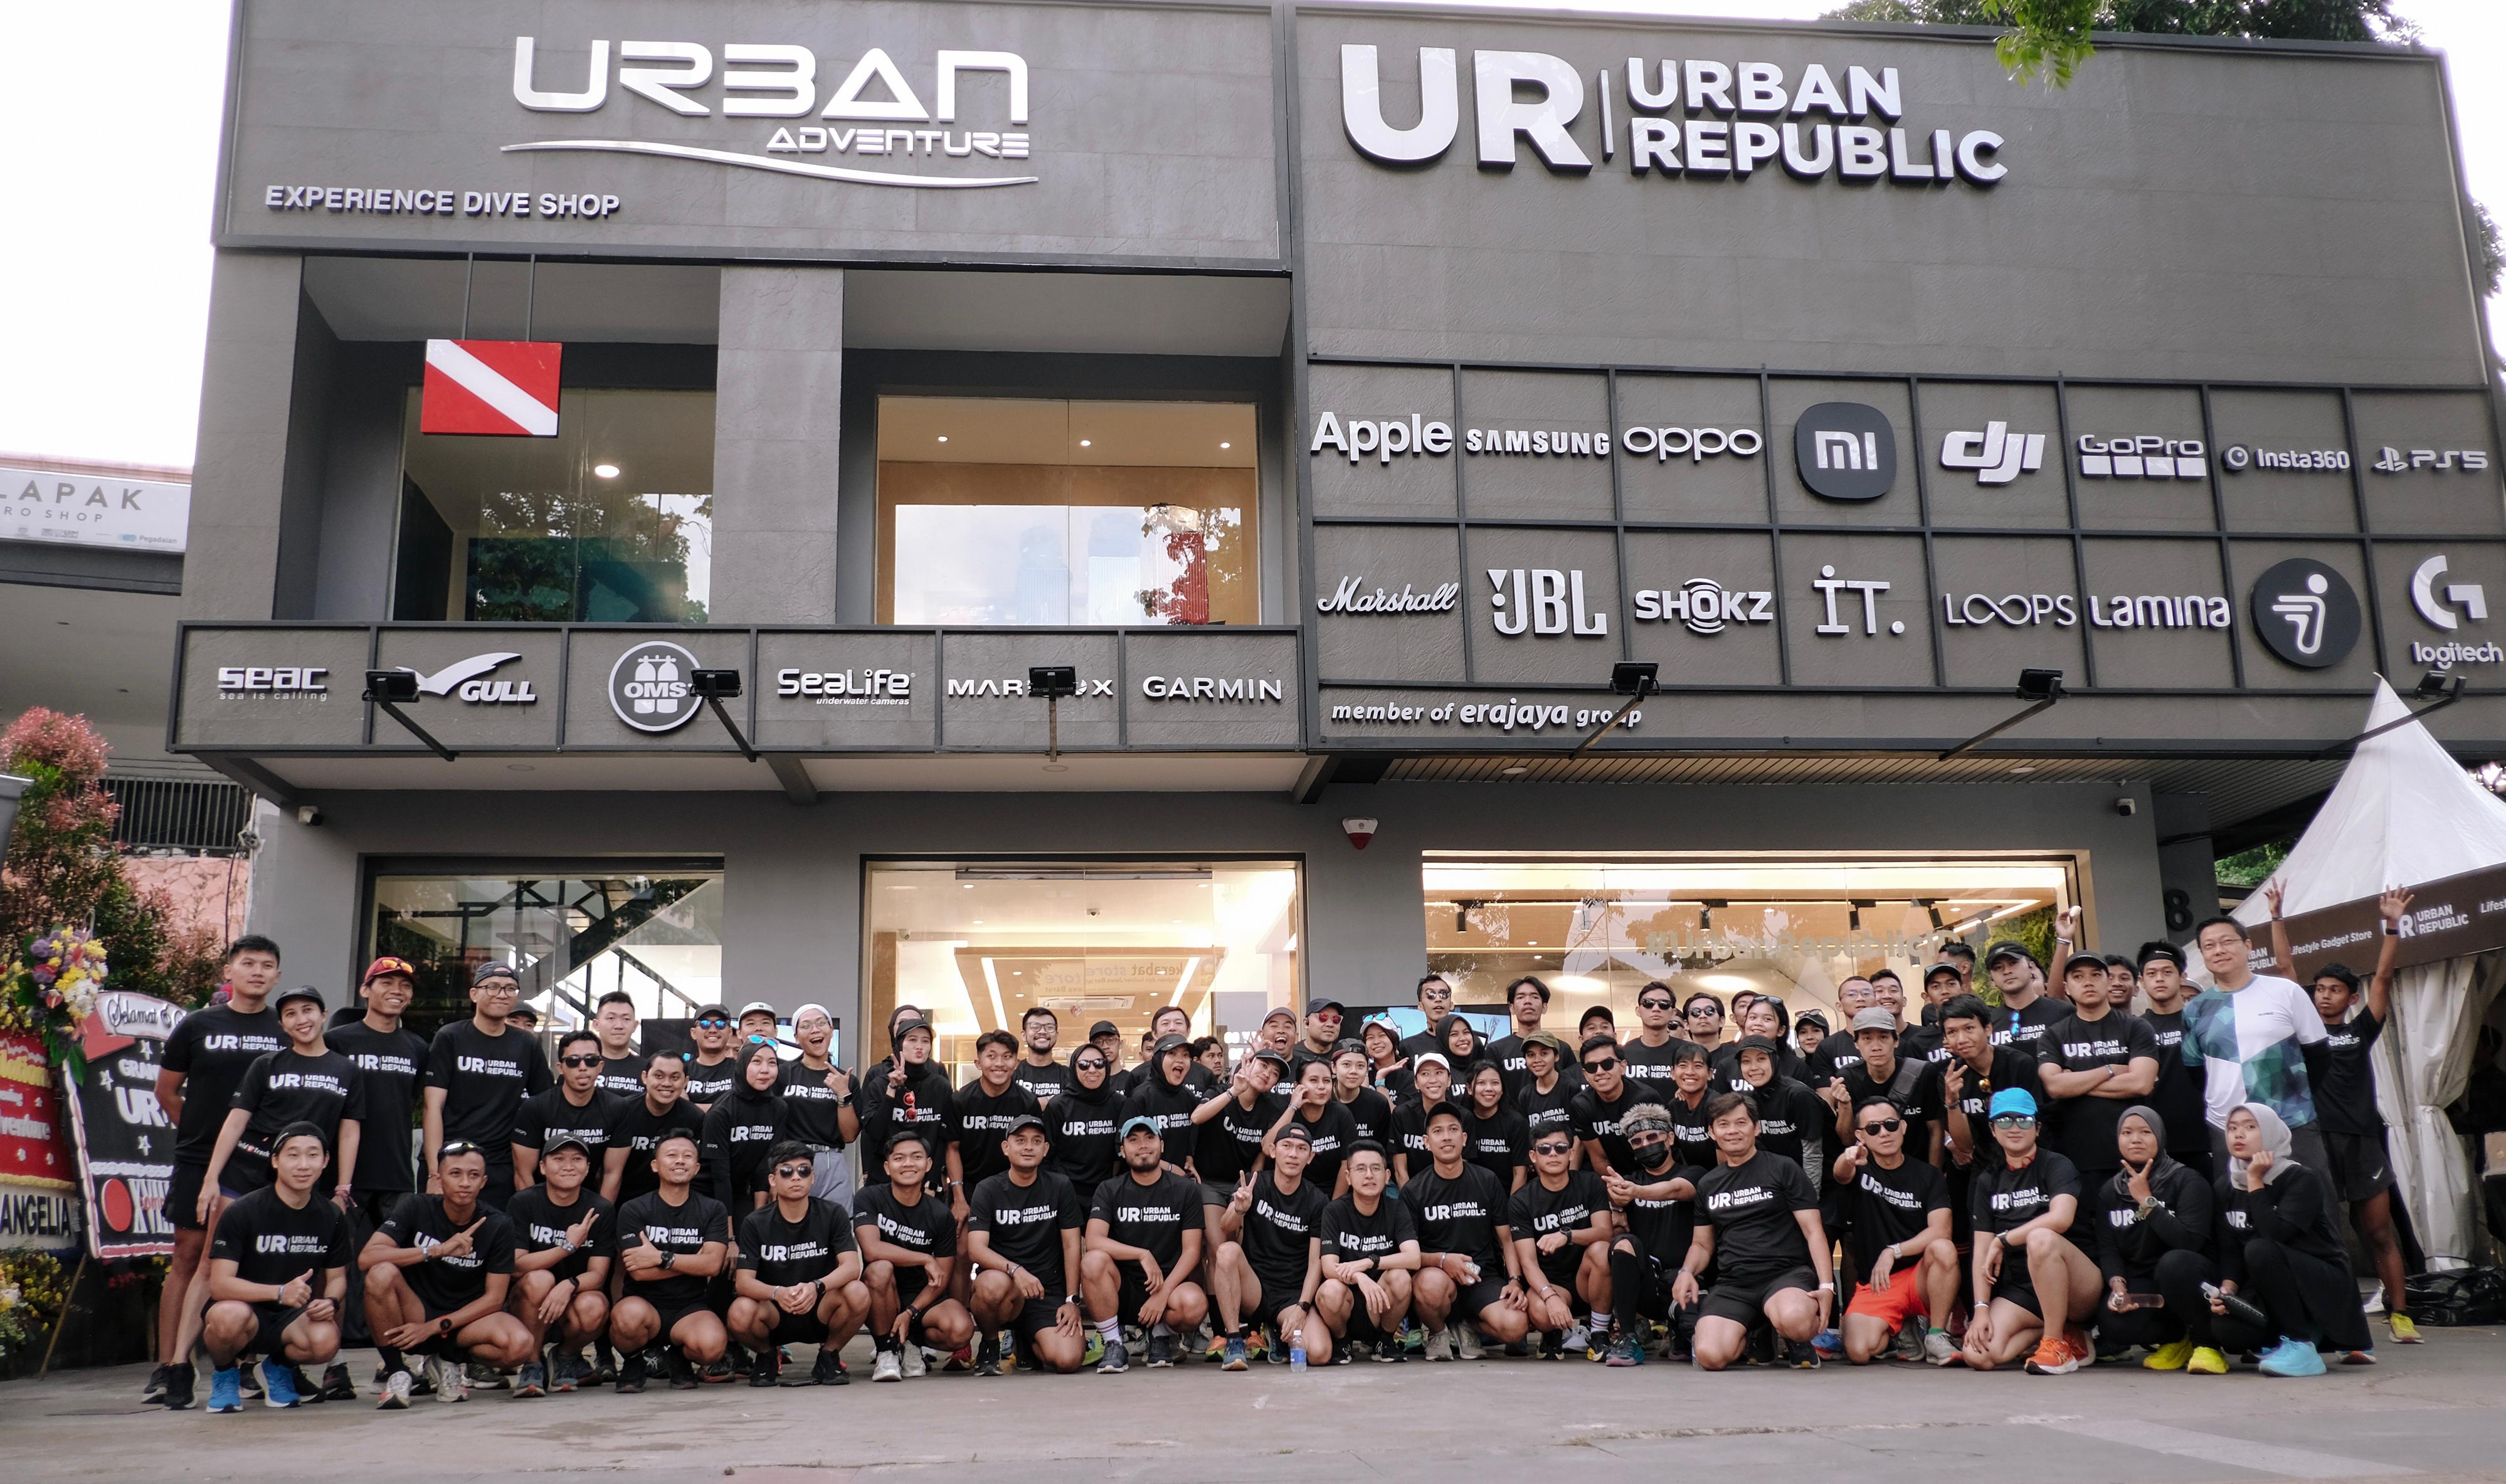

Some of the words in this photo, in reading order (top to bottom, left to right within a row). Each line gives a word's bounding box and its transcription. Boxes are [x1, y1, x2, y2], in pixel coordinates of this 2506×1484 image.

[513, 36, 1029, 124] URBAN
[1626, 57, 1901, 124] URBAN
[1338, 43, 1594, 175] UR
[767, 127, 1030, 158] ADVENTURE
[1631, 117, 2009, 187] REPUBLIC
[266, 185, 455, 213] EXPERIENCE
[463, 191, 531, 217] DIVE
[538, 193, 620, 219] SHOP
[1311, 411, 1452, 464] Apple
[1465, 429, 1610, 456] SAMSUNG
[2079, 434, 2204, 455] GoPro
[2256, 448, 2350, 470] Insta360
[2409, 450, 2488, 470] PS5
[0, 480, 144, 510] APAK
[45, 510, 102, 522] SHOP
[139, 535, 177, 544] Pegadaian
[1317, 576, 1459, 613] Marshall
[1493, 569, 1608, 636] JBL
[1634, 589, 1774, 622] SHOKZ
[1945, 592, 2077, 626] LOOPS
[2412, 641, 2504, 670] logitech
[623, 681, 688, 699] OMS
[777, 668, 911, 697] SeaLife
[1142, 675, 1282, 701] GARMIN
[219, 692, 245, 700] sea
[253, 692, 266, 700] is
[273, 691, 327, 702] calling
[458, 680, 537, 705] GULL
[816, 697, 869, 705] underwater
[870, 698, 910, 707] cameras
[1331, 702, 1424, 722] member
[1430, 702, 1454, 722] of
[1460, 697, 1568, 730] erajaya
[2416, 903, 2453, 923] URBAN
[2418, 913, 2469, 935] REPUBLIC
[2320, 935, 2350, 950] Gadget
[2350, 929, 2372, 944] Store
[205, 1034, 238, 1050] UR
[242, 1036, 277, 1044] URBAN
[2064, 1043, 2092, 1058] UR
[382, 1056, 410, 1065] URBAN
[458, 1056, 484, 1073] UR
[488, 1060, 516, 1068] URBAN
[305, 1075, 338, 1085] URBAN
[487, 1067, 523, 1078] REPUBLIC
[269, 1073, 300, 1089] UR
[608, 1082, 645, 1092] REPUBLIC
[609, 1076, 637, 1085] URBAN
[706, 1078, 732, 1087] URBAN
[304, 1081, 347, 1096] REPUBLIC
[784, 1085, 808, 1098] UR
[1542, 1108, 1565, 1117] URBAN
[963, 1115, 986, 1129] UR
[1062, 1121, 1086, 1136] UR
[1089, 1127, 1116, 1135] REPUBLI
[1239, 1127, 1262, 1136] URBAN
[1733, 1186, 1762, 1197] URBAN
[1734, 1192, 1774, 1205] REPUBLIC
[1883, 1188, 1913, 1200] URBAN
[1023, 1204, 1050, 1215] URBAN
[1257, 1199, 1273, 1220] UR
[1452, 1202, 1478, 1210] URBAN
[1708, 1194, 1731, 1210] UR
[996, 1209, 1021, 1224] UR
[1118, 1208, 1140, 1222] UR
[1143, 1213, 1180, 1222] REPUBLIC
[1274, 1211, 1301, 1223] URBAN
[1425, 1205, 1450, 1221] UR
[1452, 1208, 1486, 1218] REPUBLIC
[1560, 1204, 1584, 1216] URBAN
[1273, 1219, 1308, 1232] REPUBLIC
[1534, 1213, 1560, 1231] UR
[899, 1225, 925, 1238] URBAN
[256, 1235, 287, 1253] UR
[670, 1236, 704, 1244] REPUBLI
[791, 1241, 817, 1252] URBAN
[1340, 1231, 1360, 1250] UR
[1362, 1241, 1393, 1251] REPUBLIC
[1363, 1234, 1387, 1245] URBAN
[761, 1245, 787, 1261] UR
[791, 1248, 828, 1260] REPUBLIC
